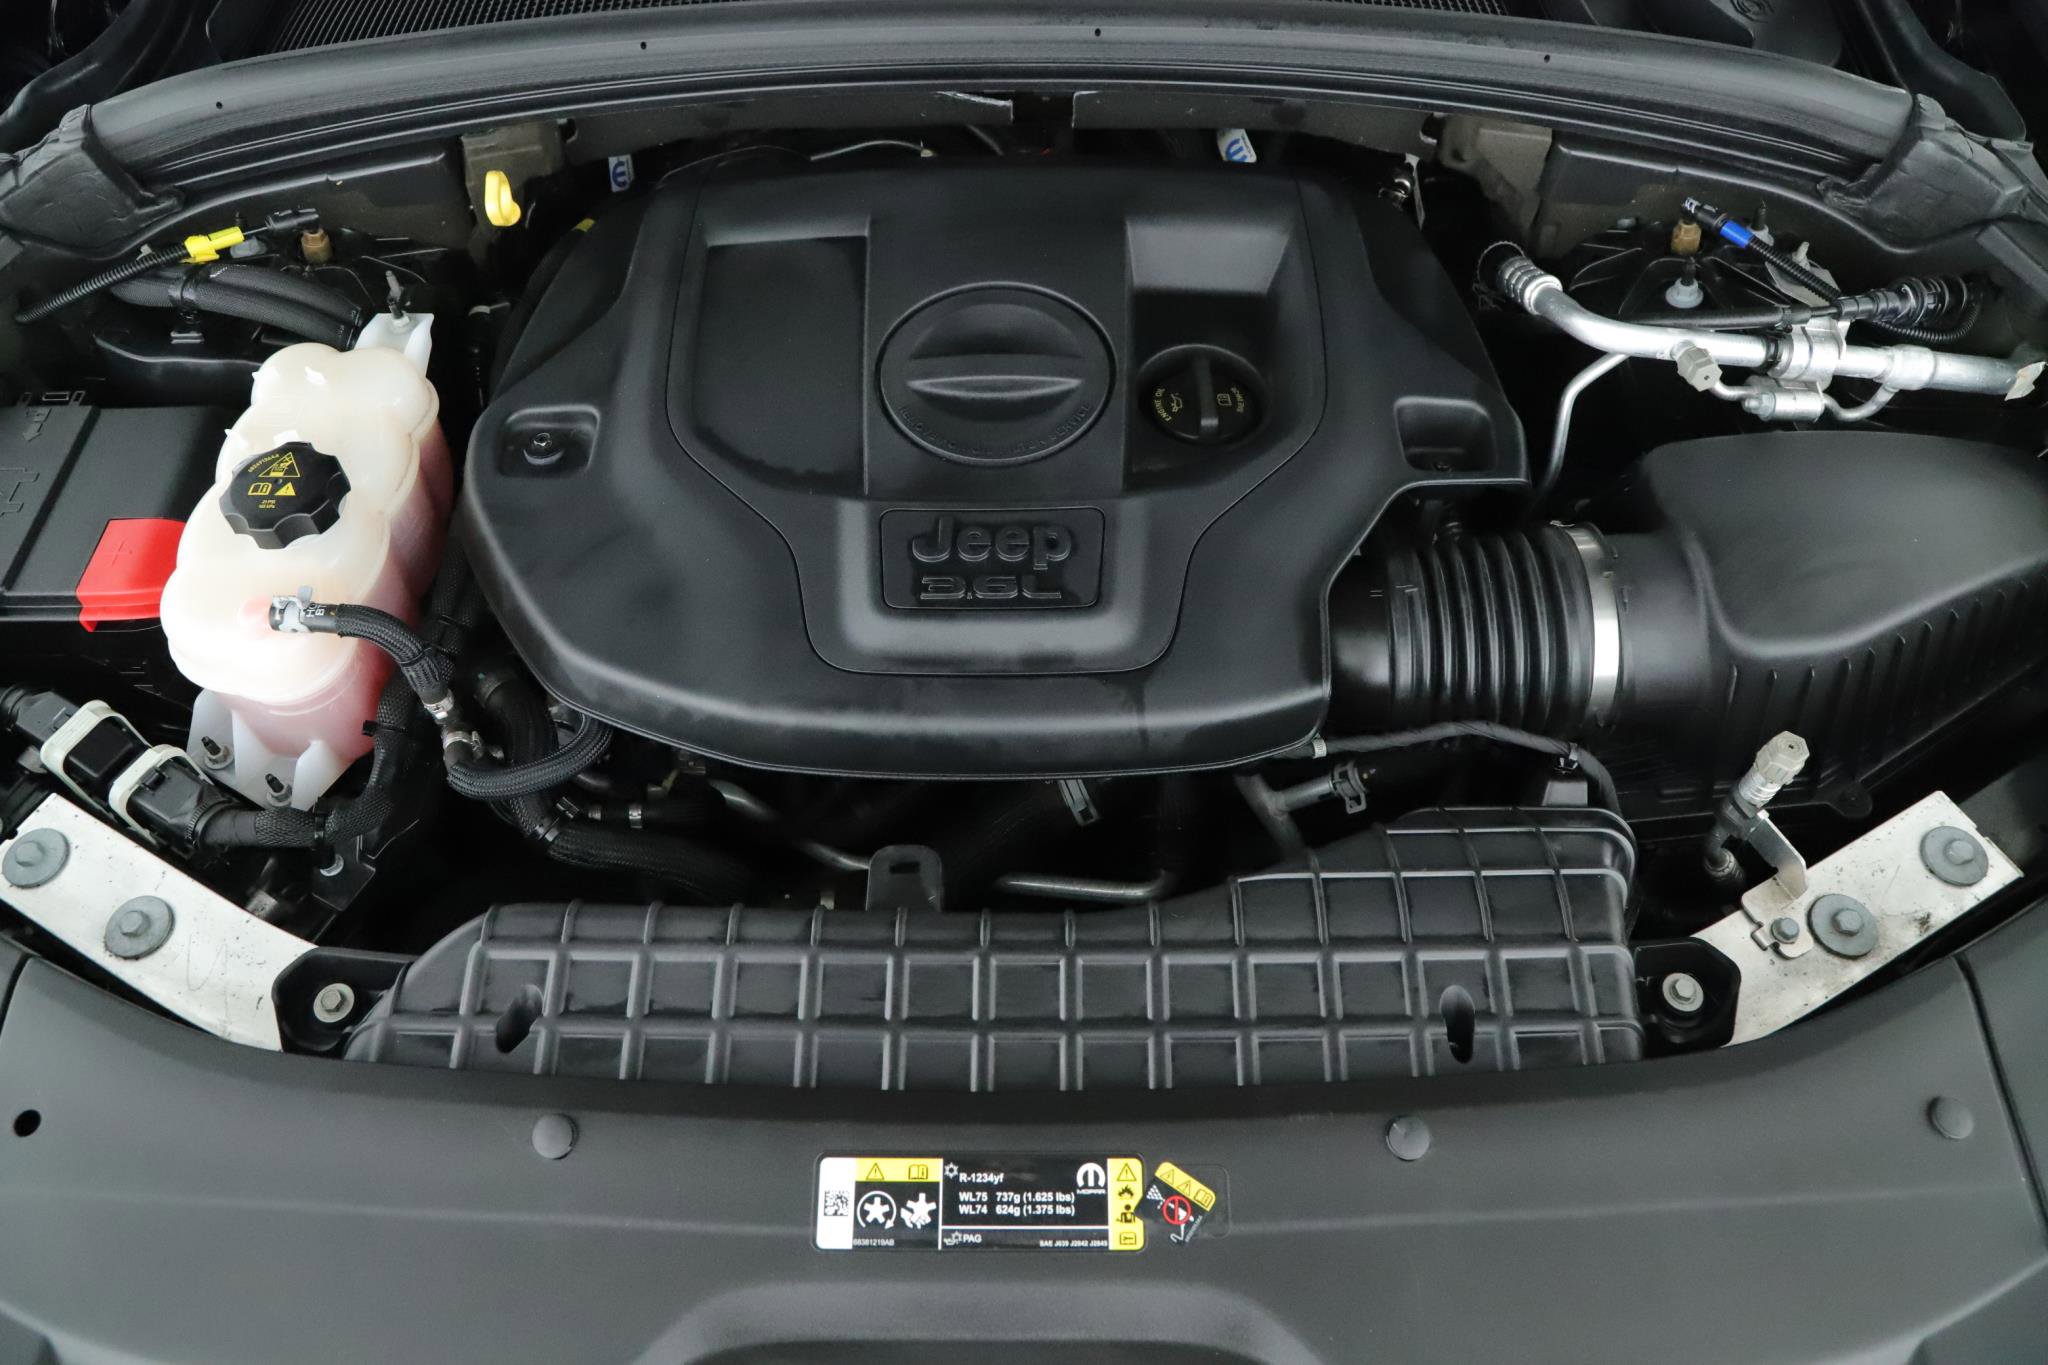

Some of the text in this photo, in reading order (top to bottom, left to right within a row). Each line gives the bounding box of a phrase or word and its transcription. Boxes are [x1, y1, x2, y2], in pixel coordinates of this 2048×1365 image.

[911, 517, 1073, 571] Jeep
[919, 575, 1063, 600] 3.6L
[958, 1172, 1004, 1185] R-1234yf
[958, 1191, 1075, 1204] WL75 737g (1.625 lbs)
[958, 1204, 1076, 1217] WL74 624g (1.375 lbs)
[963, 1234, 982, 1244] PAG
